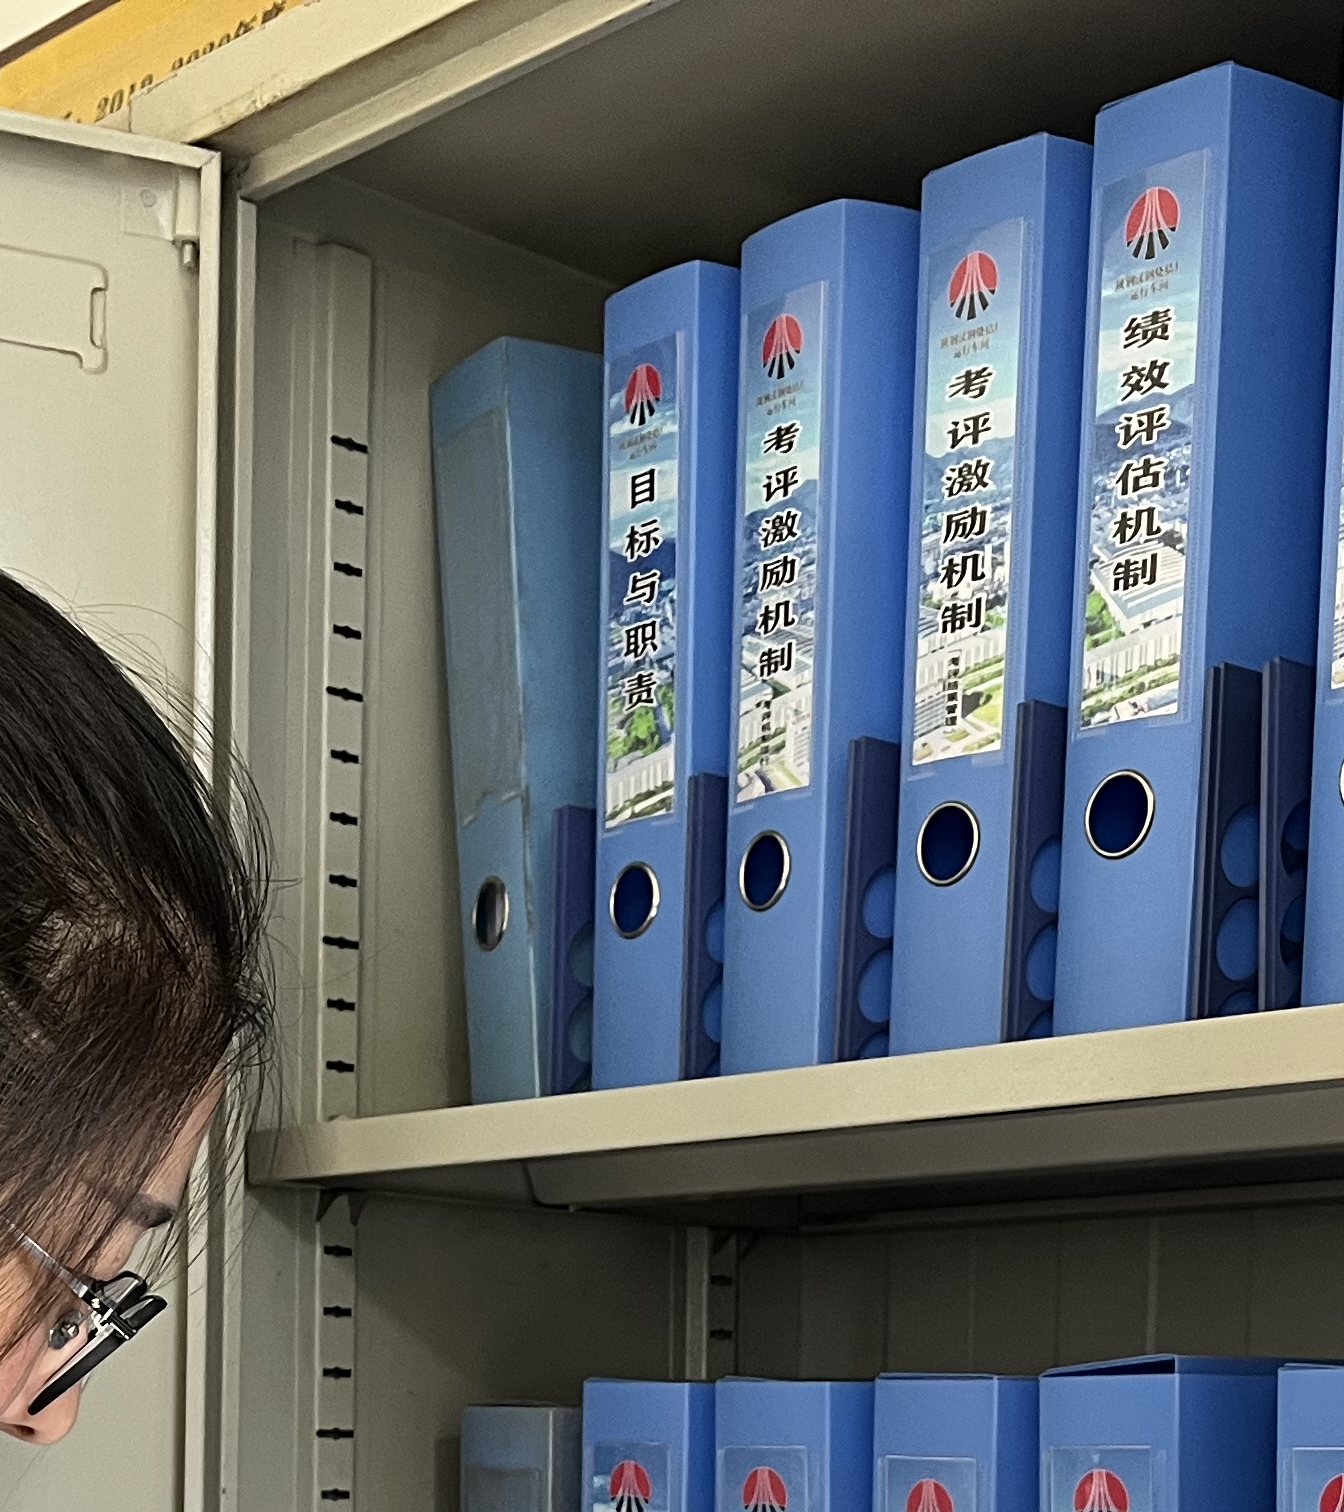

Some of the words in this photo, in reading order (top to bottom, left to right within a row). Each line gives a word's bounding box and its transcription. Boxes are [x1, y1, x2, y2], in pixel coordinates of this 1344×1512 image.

[759, 424, 799, 677] 考评激励机制
[940, 367, 993, 633] 考评激励机制
[1112, 310, 1174, 592] 绩效评估机制
[624, 469, 660, 709] 目标与职责
